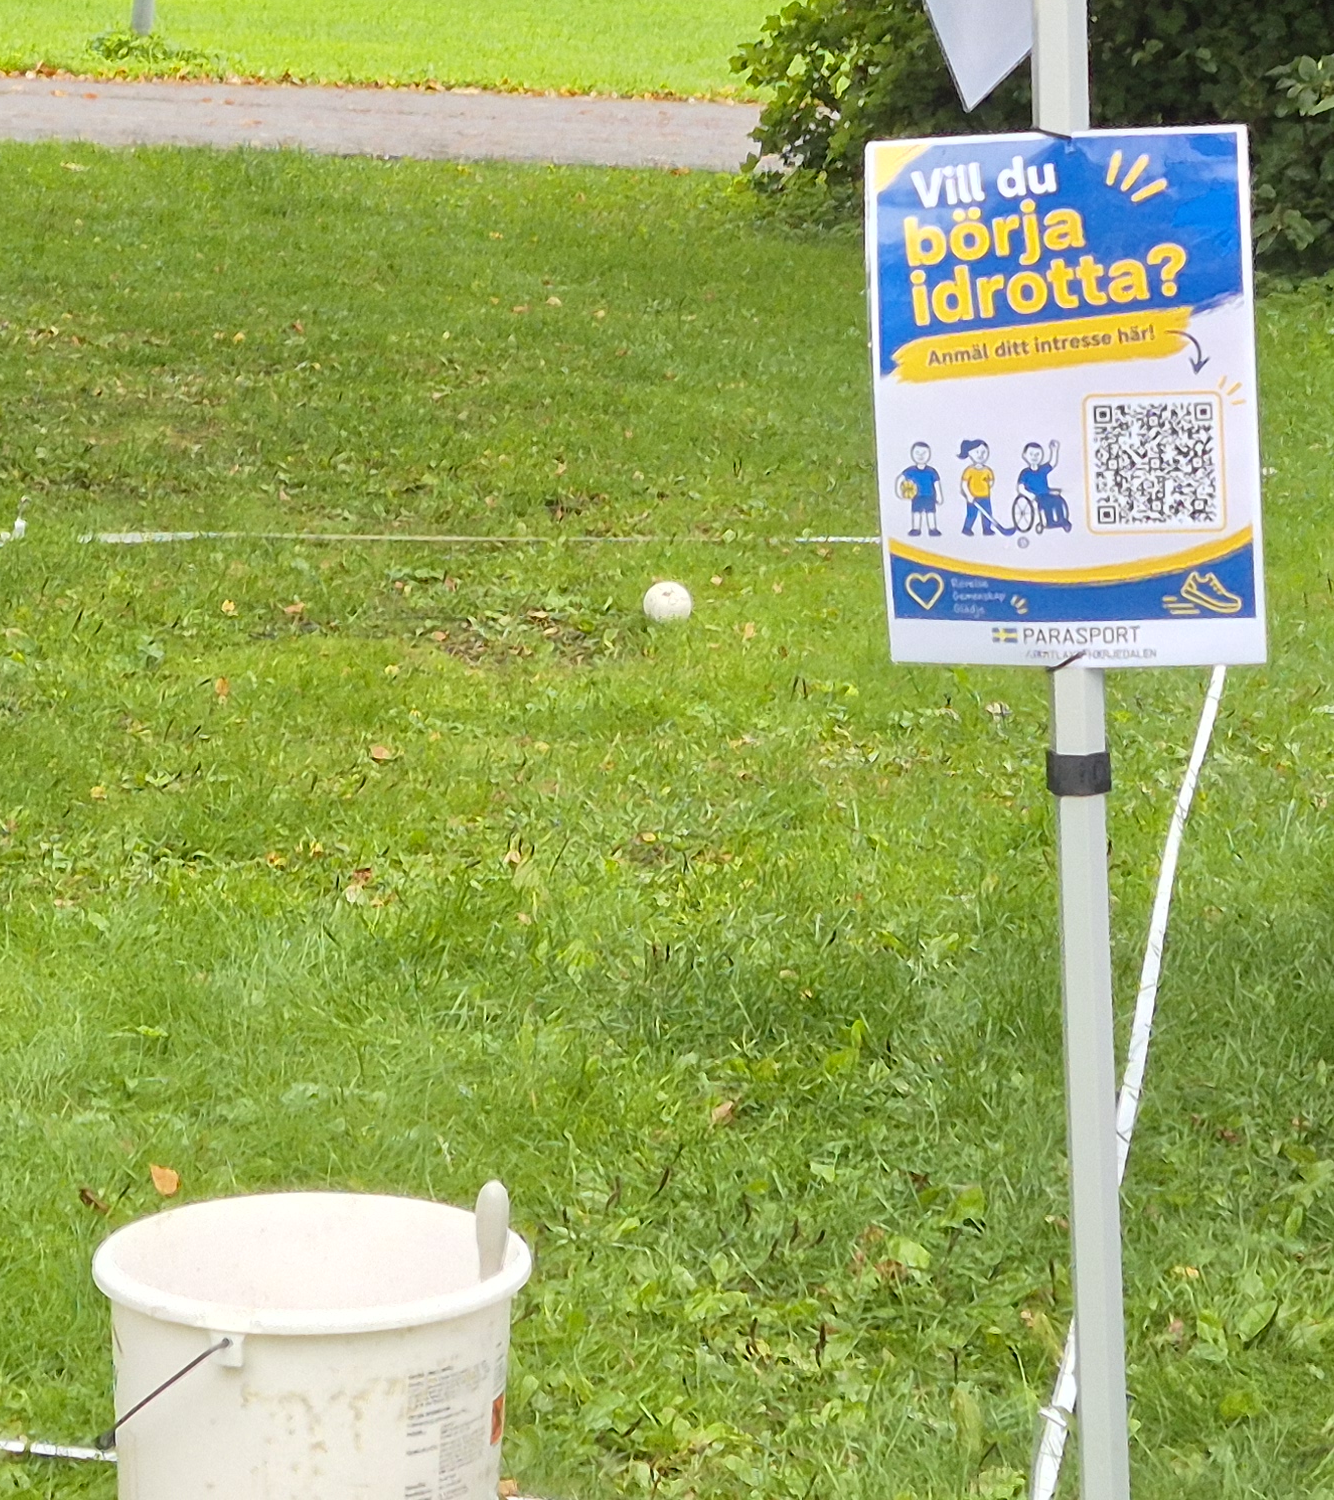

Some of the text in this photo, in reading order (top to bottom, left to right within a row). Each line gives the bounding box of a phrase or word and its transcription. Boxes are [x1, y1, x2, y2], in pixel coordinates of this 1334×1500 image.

[910, 155, 1058, 208] Vill du
[903, 198, 1086, 267] börja
[909, 242, 1187, 326] idrotta?
[927, 324, 1156, 367] Anmäl ditt intresse här!
[1023, 626, 1141, 645] PARASPORT
